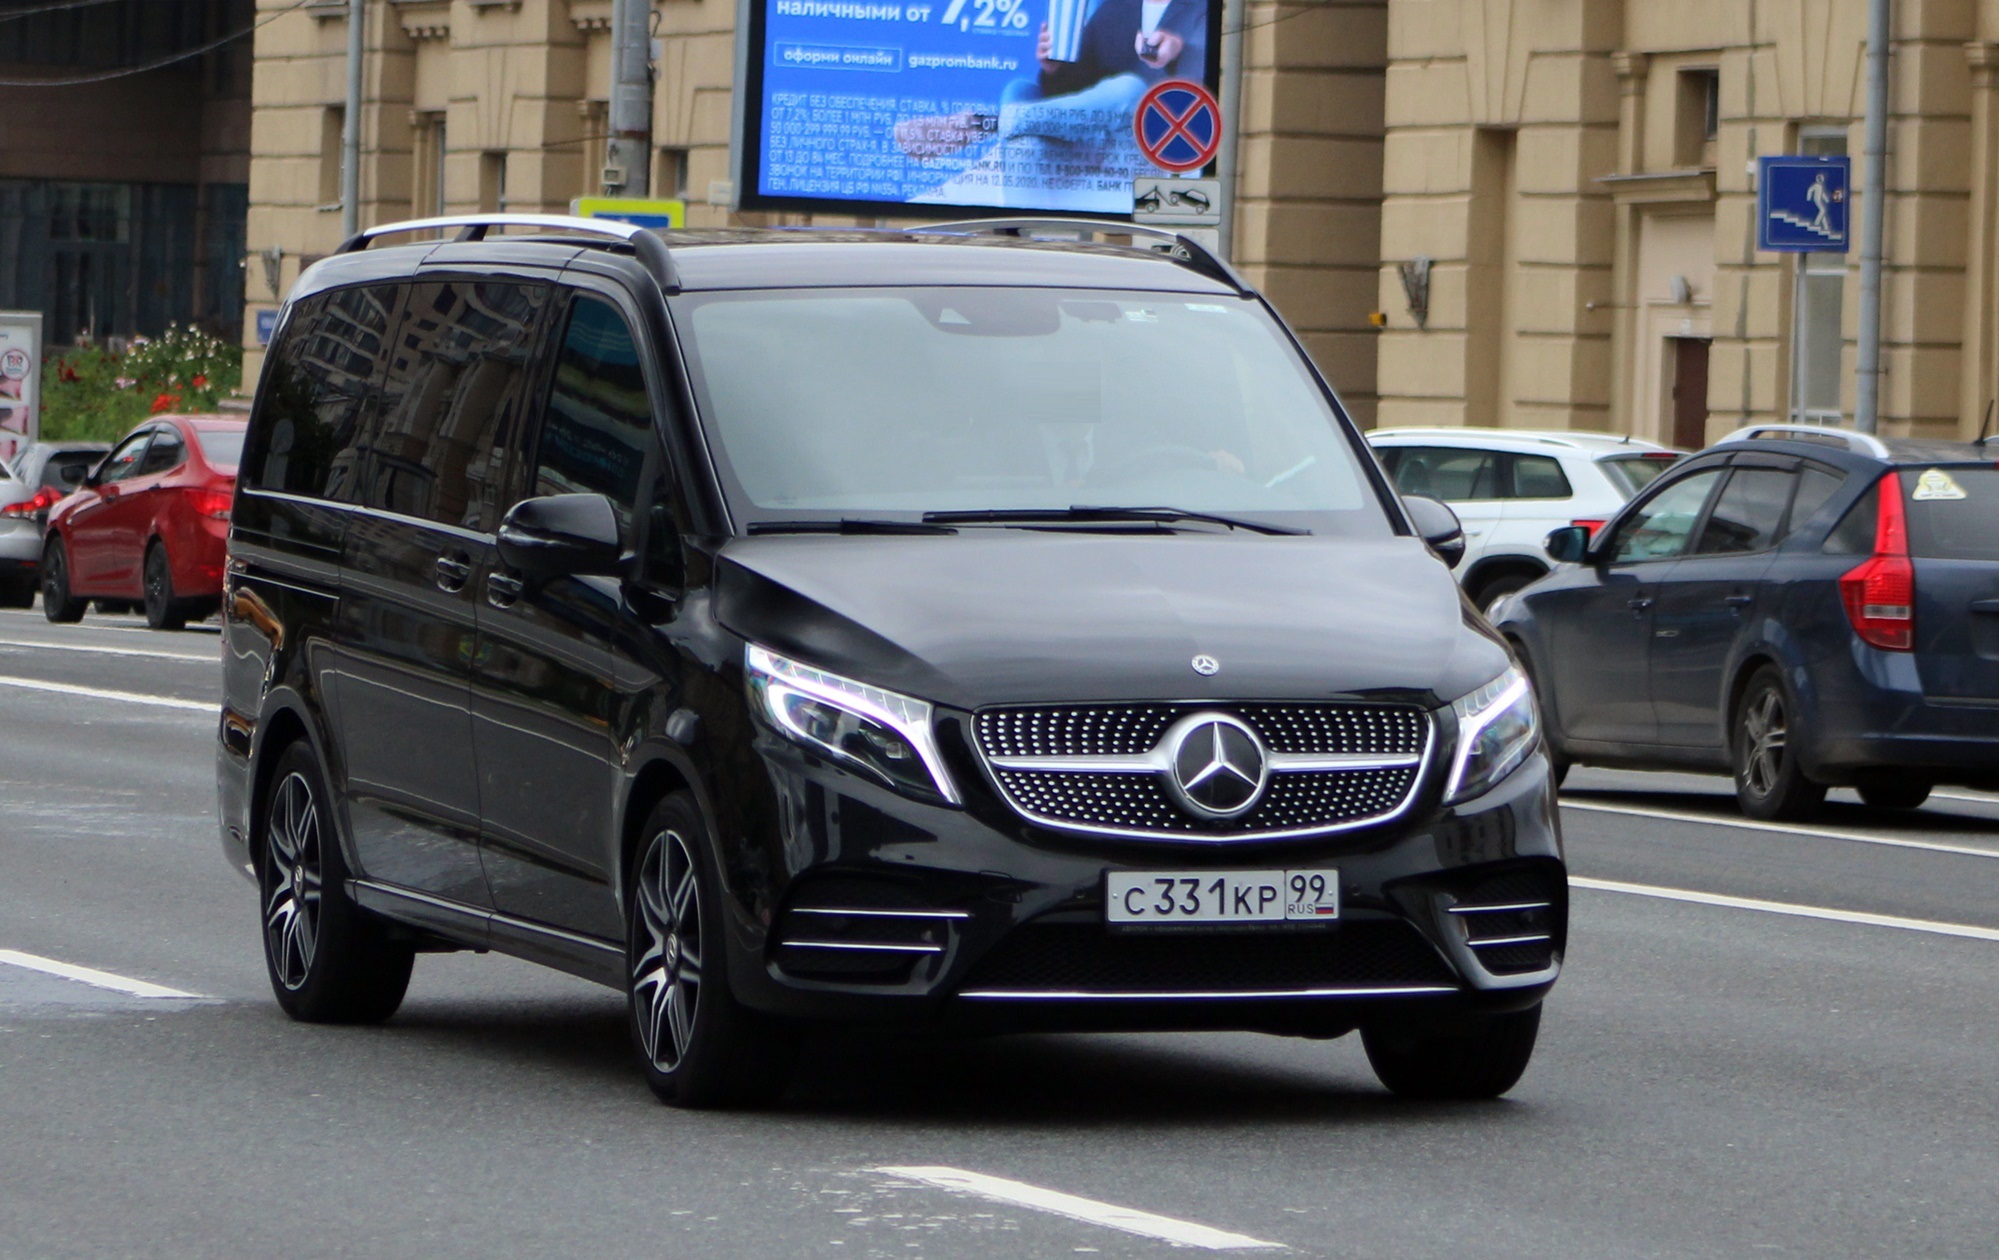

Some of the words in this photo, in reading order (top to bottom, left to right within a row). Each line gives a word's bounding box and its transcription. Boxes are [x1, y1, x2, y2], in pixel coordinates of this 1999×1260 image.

[777, 0, 901, 21] наличными
[906, 6, 932, 23] от
[784, 47, 840, 64] оформи
[843, 51, 893, 66] онлайн
[908, 55, 1018, 71] gazprombank.ru
[771, 93, 807, 107] КРЕДИТ
[810, 94, 827, 107] БЕЗ
[771, 107, 786, 119] ОТ
[812, 108, 843, 123] БОЛЕЕ
[851, 111, 871, 123] МЛН
[983, 118, 997, 130] ОТ
[771, 120, 782, 134] 50
[927, 129, 964, 142] СТАВКА
[770, 135, 787, 148] БЕЗ
[965, 145, 979, 157] ОТ
[769, 149, 783, 162] ОТ
[795, 151, 810, 165] ДО
[850, 153, 904, 168] ПОДРОБНЕЕ
[907, 156, 920, 168] НА
[921, 157, 1006, 173] GAZPROMBANK.RU
[1009, 162, 1016, 172] И
[1018, 162, 1032, 174] ПО
[769, 163, 808, 177] ЗВОНОК
[810, 166, 823, 177] НА
[826, 166, 885, 181] ТЕРРИТОРИИ
[976, 174, 989, 186] НА
[1042, 177, 1055, 189] НЕ
[1097, 180, 1121, 191] БАНК
[789, 178, 840, 193] ЛИЦЕНЗИЯ
[841, 181, 855, 194] ЦБ
[856, 181, 870, 194] РФ
[1125, 878, 1277, 914] С331КР
[1290, 874, 1325, 903] 99
[1287, 903, 1315, 915] RUS
